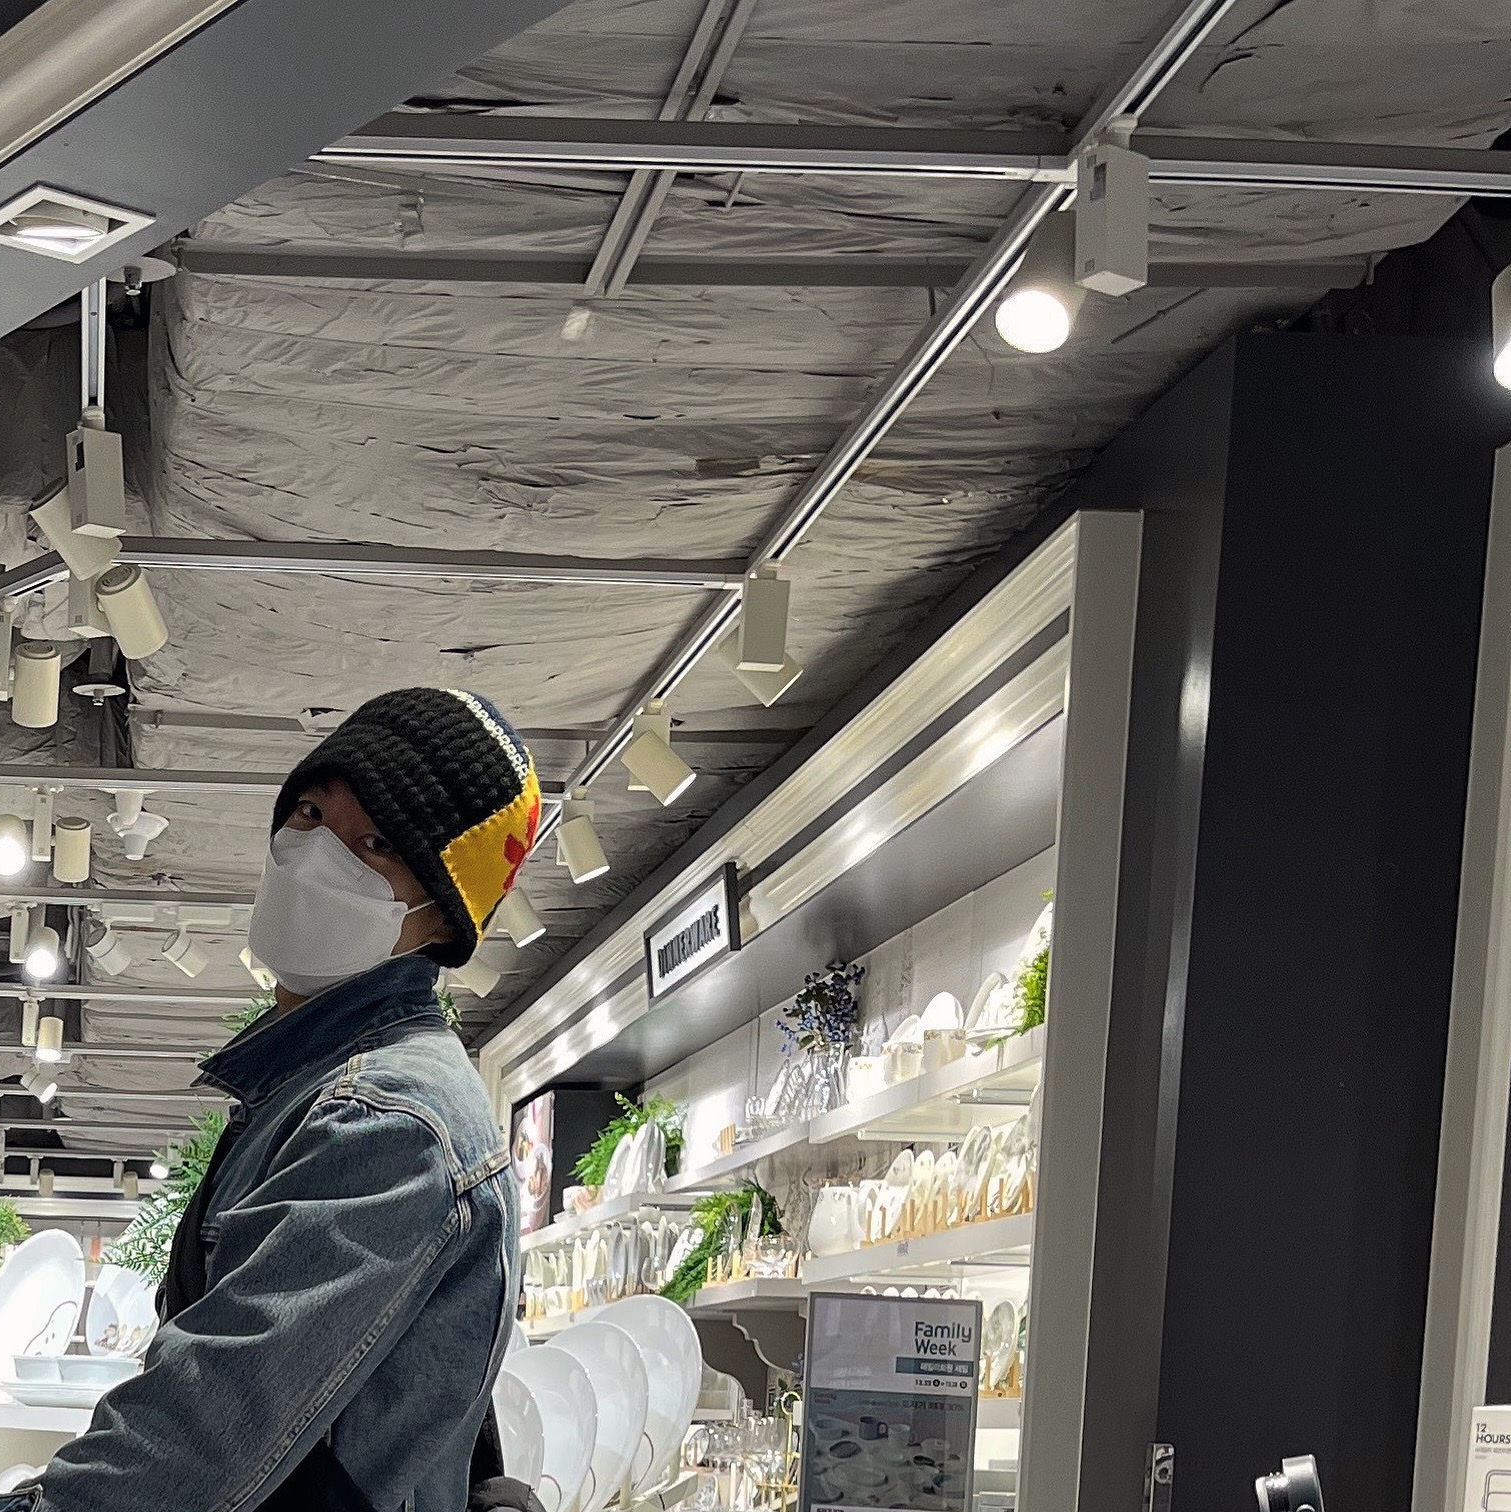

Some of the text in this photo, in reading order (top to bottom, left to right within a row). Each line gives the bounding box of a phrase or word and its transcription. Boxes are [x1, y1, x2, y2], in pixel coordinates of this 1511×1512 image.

[914, 1321, 973, 1344] Family
[914, 1338, 958, 1357] Week
[1476, 1423, 1487, 1432] 12
[1475, 1434, 1511, 1444] HOURS
